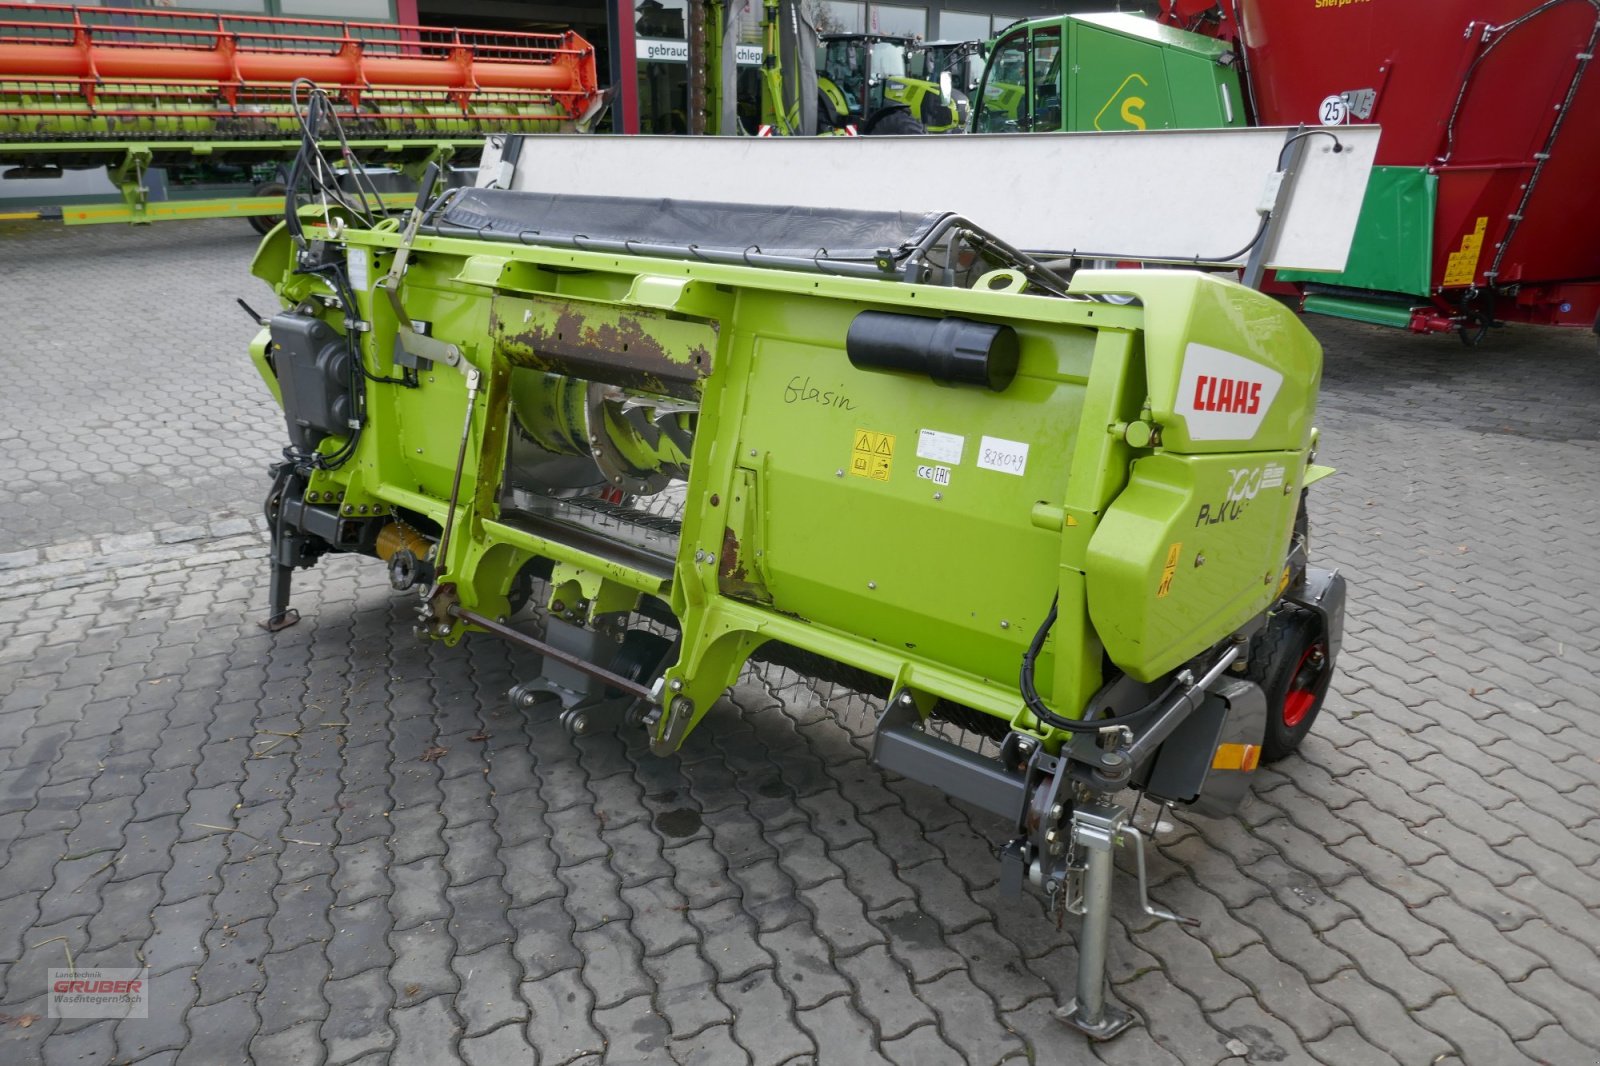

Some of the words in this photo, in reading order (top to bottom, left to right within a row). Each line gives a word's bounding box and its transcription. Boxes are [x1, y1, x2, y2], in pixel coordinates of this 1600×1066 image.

[1324, 101, 1340, 121] 25
[1193, 375, 1263, 415] CLAAS
[918, 466, 932, 479] CE
